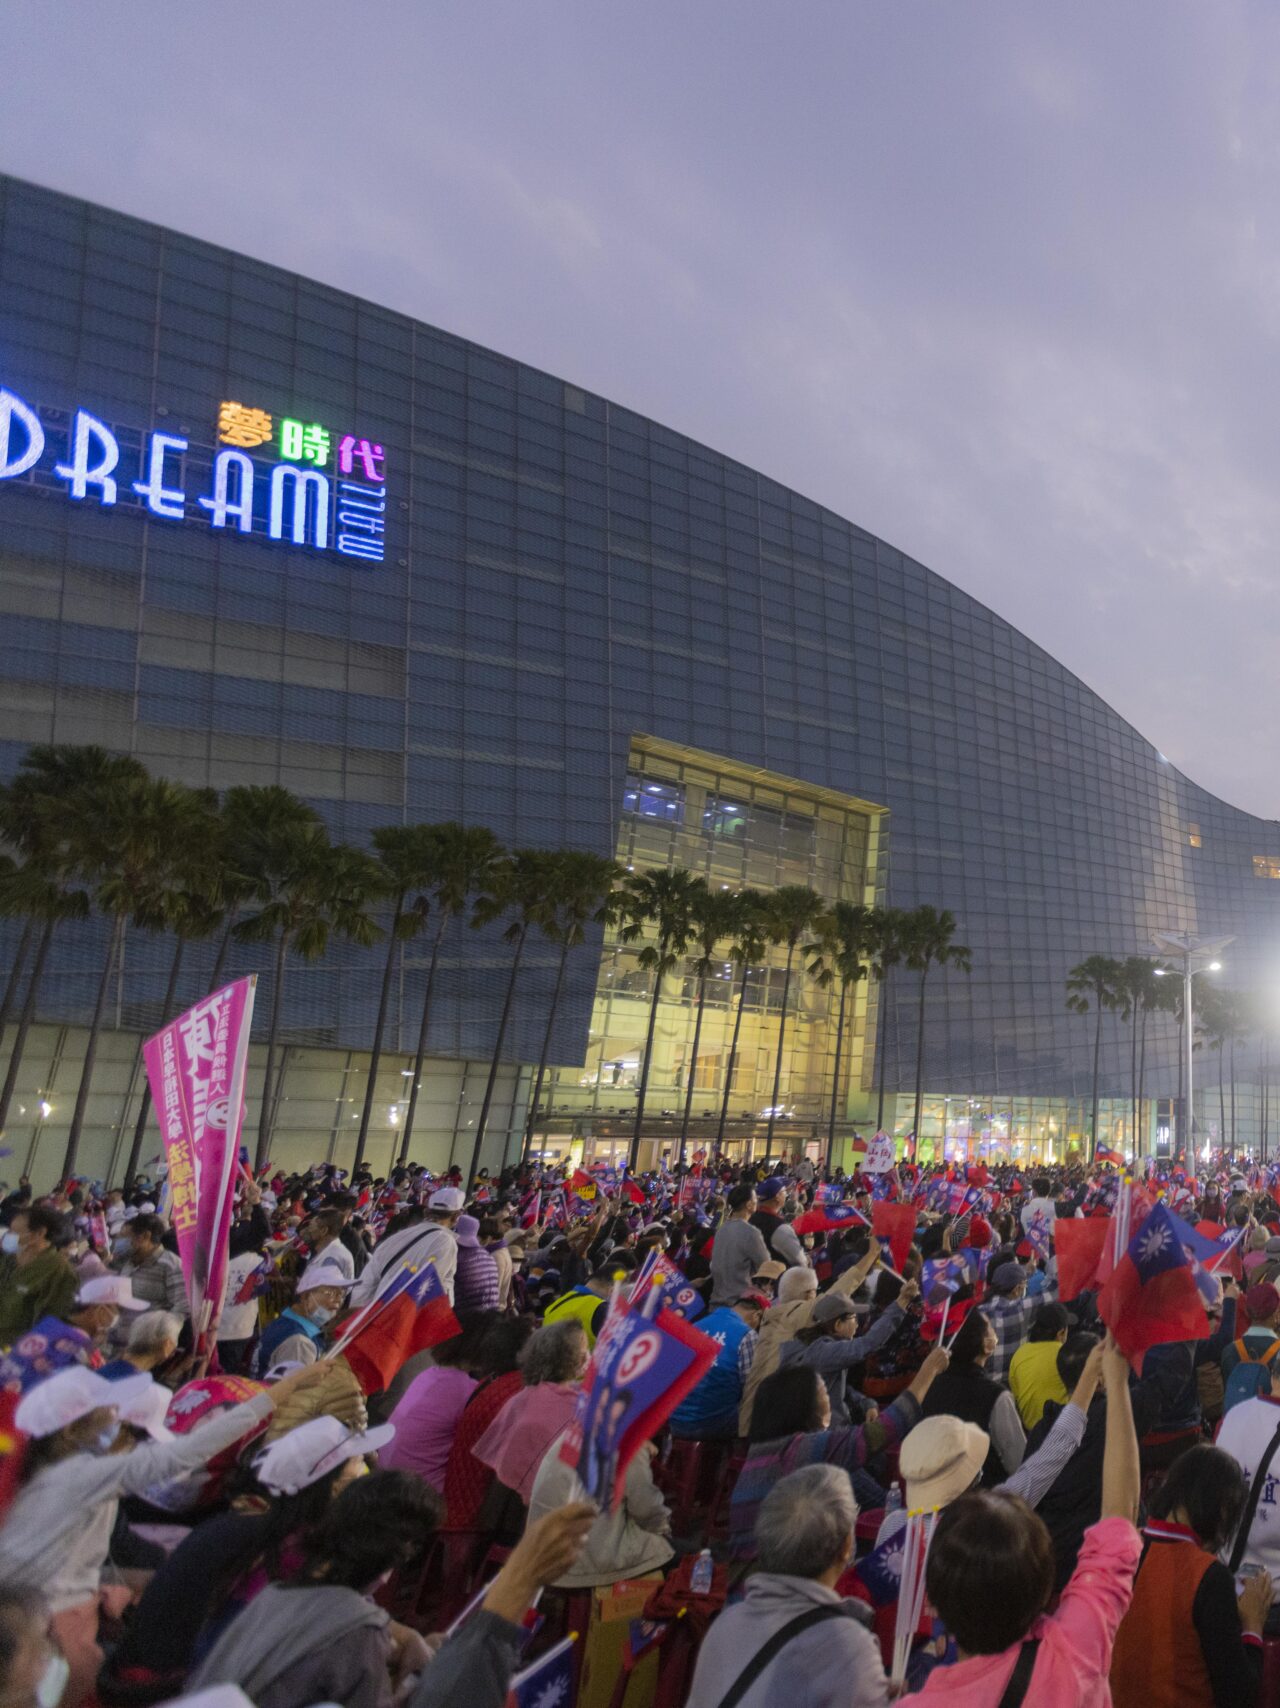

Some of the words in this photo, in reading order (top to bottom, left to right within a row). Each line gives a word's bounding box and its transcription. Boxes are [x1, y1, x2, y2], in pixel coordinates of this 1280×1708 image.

[0, 387, 330, 548] DREAM
[218, 400, 386, 481] 夢時代
[618, 1340, 652, 1377] 3
